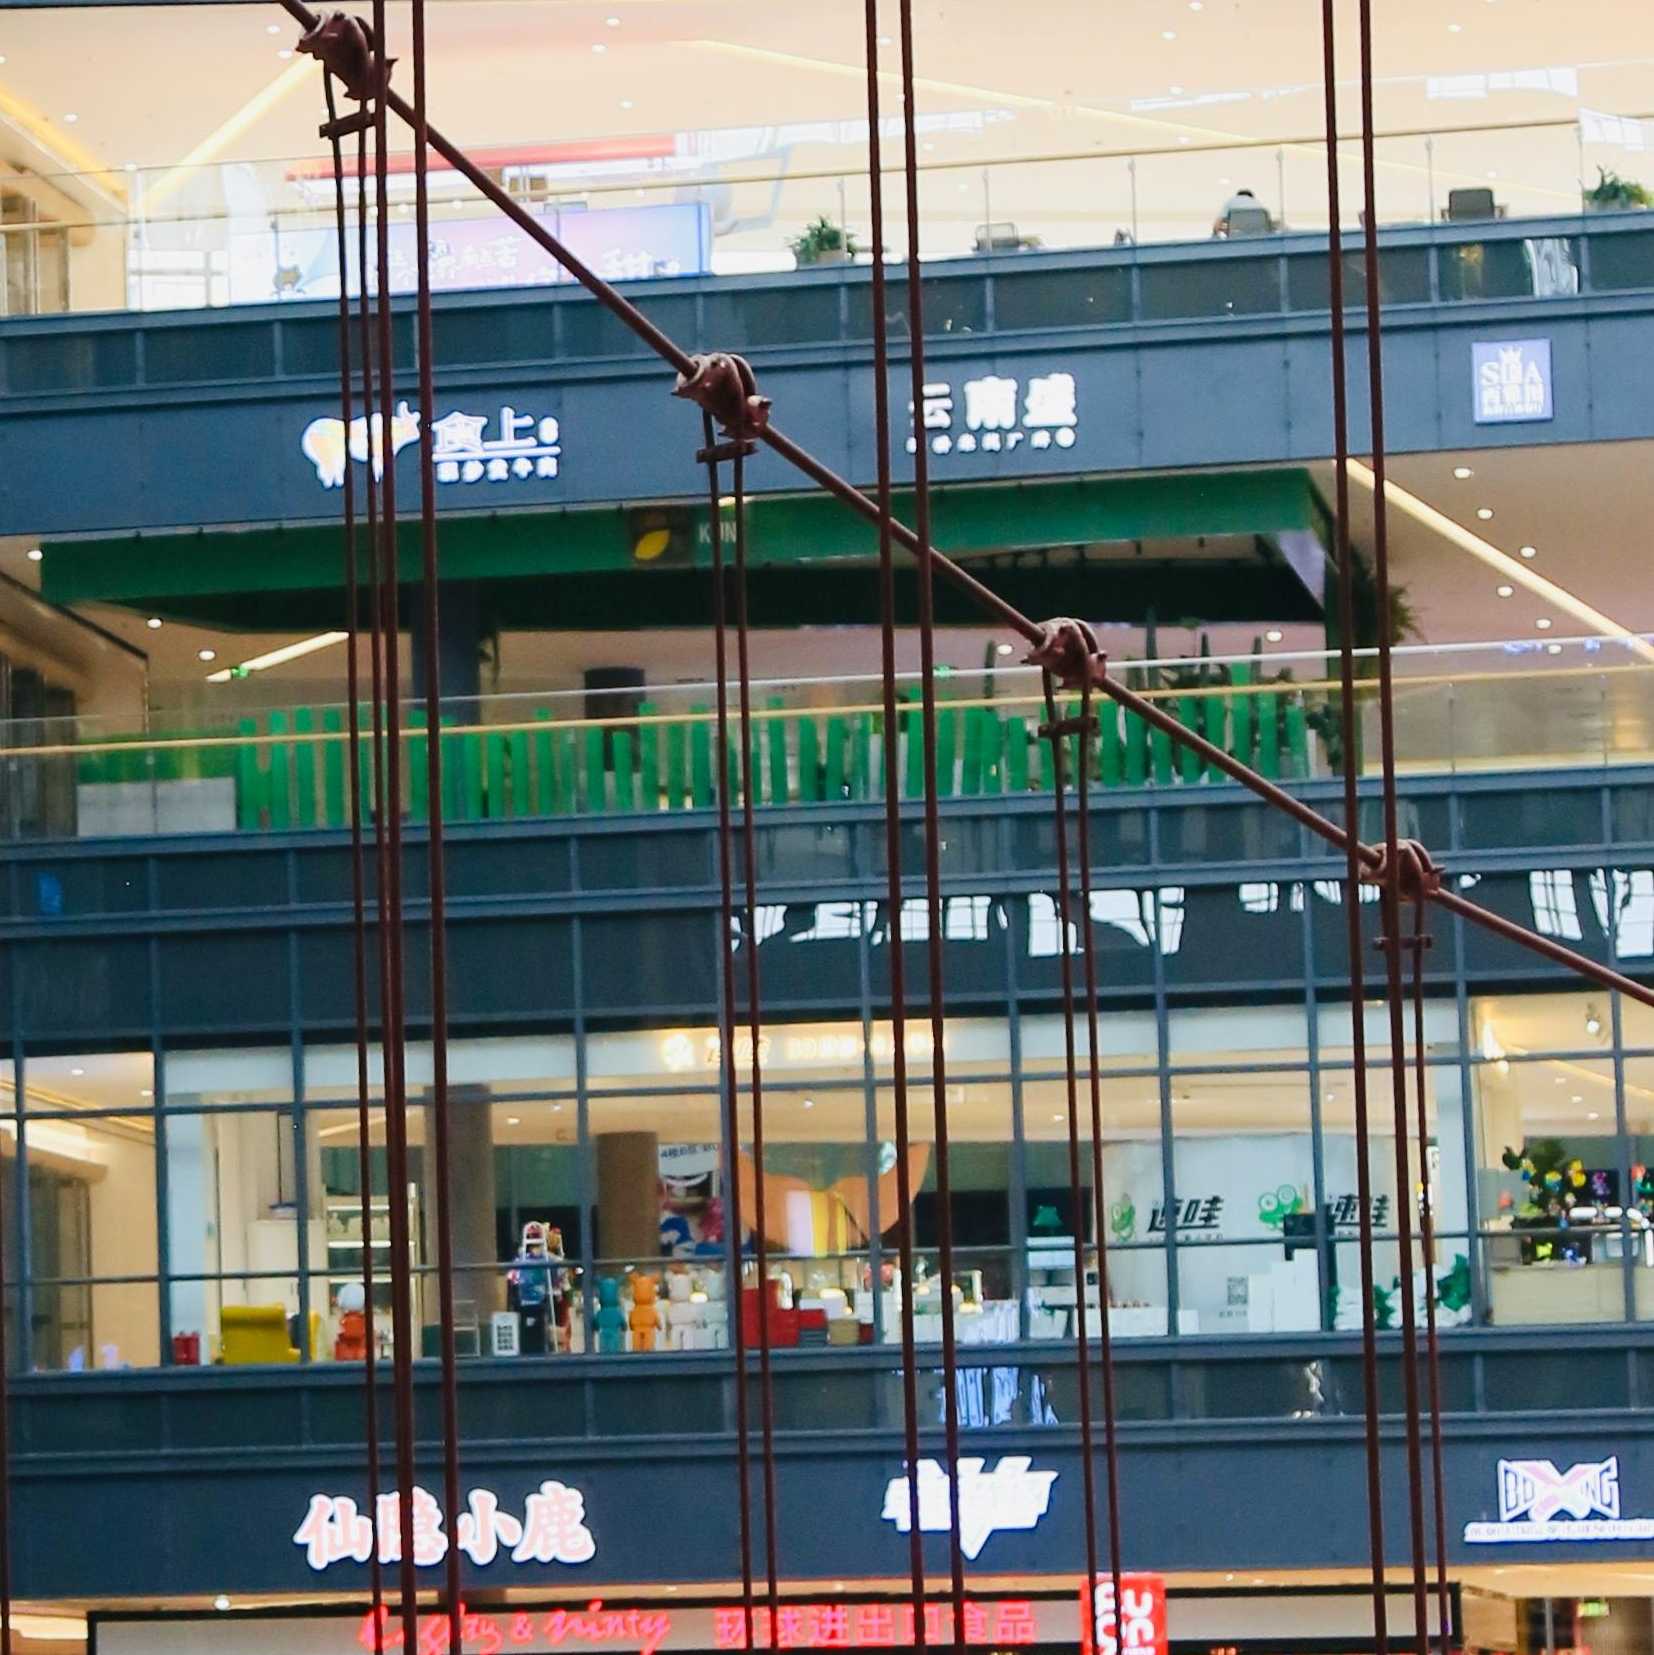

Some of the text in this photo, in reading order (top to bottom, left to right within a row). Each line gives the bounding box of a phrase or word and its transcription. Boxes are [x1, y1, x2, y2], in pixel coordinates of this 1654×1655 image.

[292, 1480, 596, 1571] 仙隐小鹿
[713, 1600, 1037, 1650] 环球进出口食品
